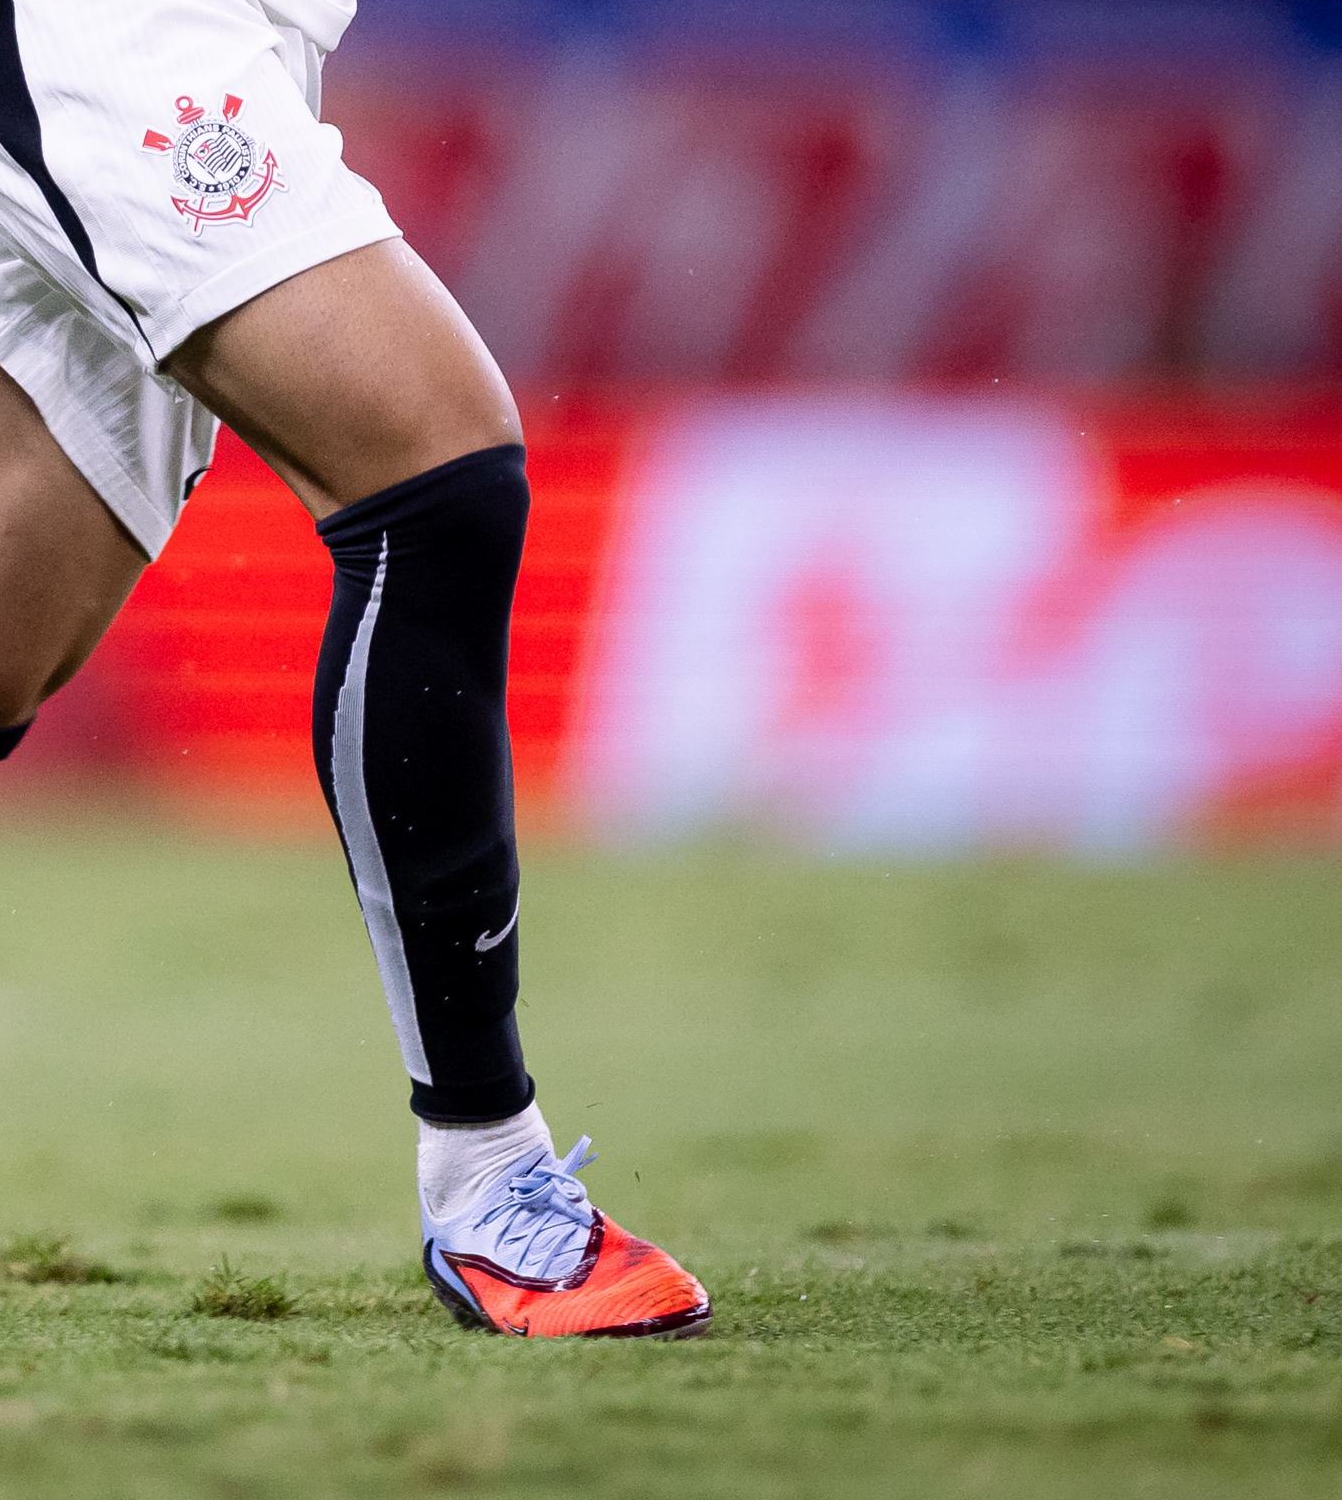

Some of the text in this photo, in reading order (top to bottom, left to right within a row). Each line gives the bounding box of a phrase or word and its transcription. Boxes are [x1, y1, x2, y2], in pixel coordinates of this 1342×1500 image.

[178, 123, 220, 179] CORINTHIANS
[221, 125, 251, 168] PAULISTA
[216, 175, 242, 192] 1910
